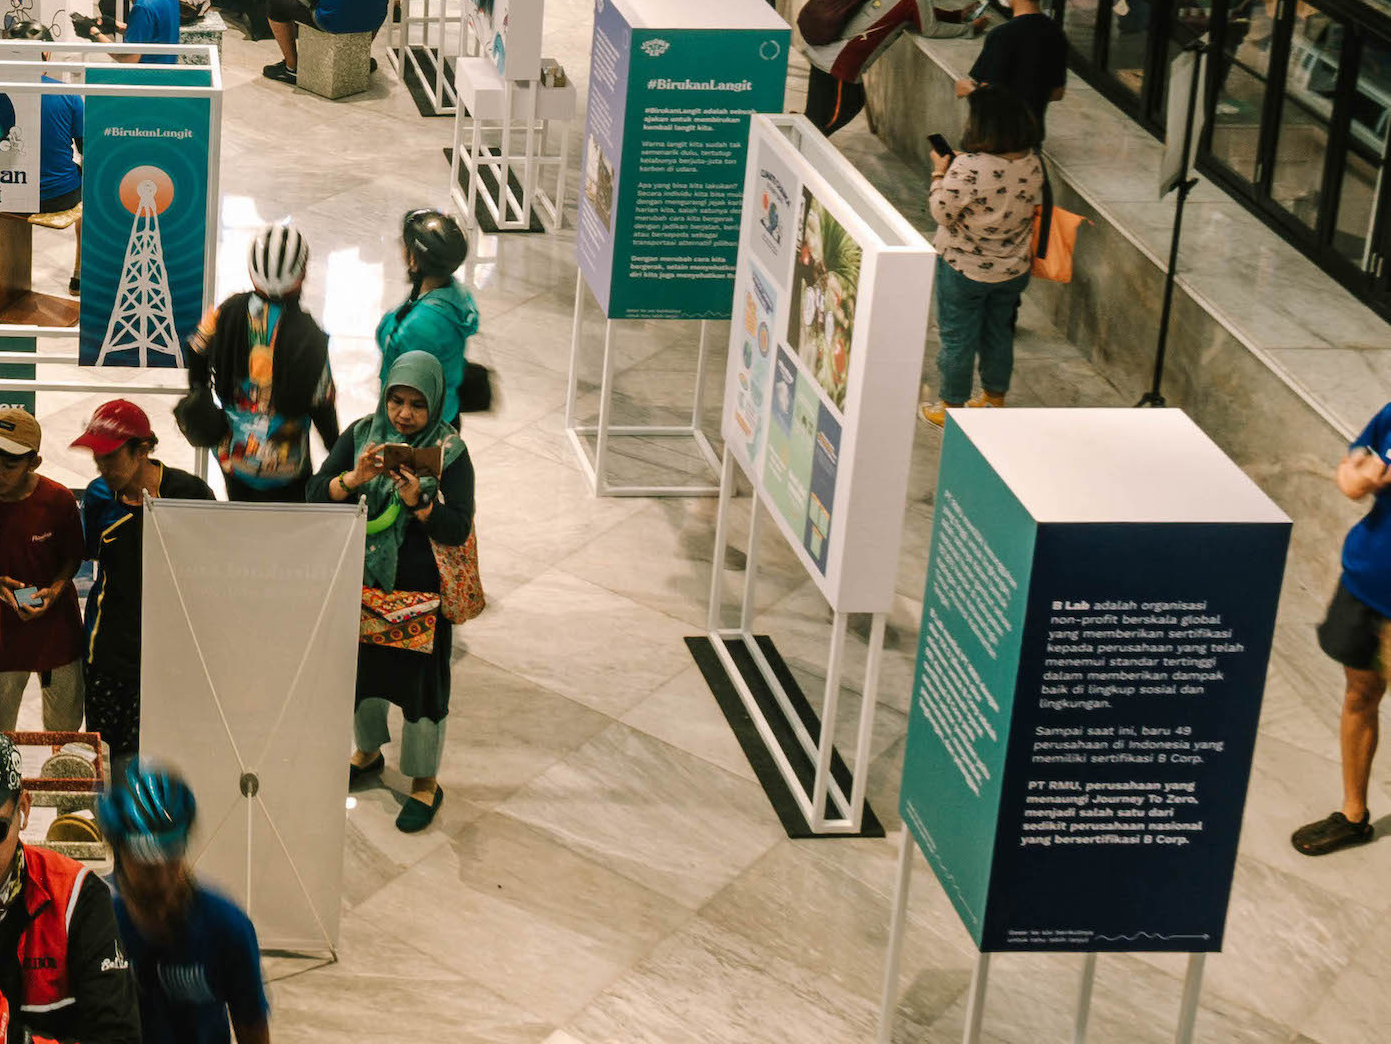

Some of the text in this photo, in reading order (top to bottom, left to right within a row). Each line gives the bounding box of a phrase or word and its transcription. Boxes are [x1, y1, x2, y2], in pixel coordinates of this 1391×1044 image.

[647, 79, 752, 92] #BirukanLangit
[104, 127, 193, 141] #BirukanLangit
[1052, 601, 1207, 612] B Lab adalah organisasi
[1051, 615, 1221, 626] non-profit berskala global
[1048, 629, 1232, 641] yang memberikan sertifikasi
[1047, 643, 1244, 654] kepada perusahaan yang telah
[1045, 657, 1216, 668] menemui standar tertinggi
[1043, 671, 1224, 682] dalam memberikan dampak
[1041, 685, 1204, 696] baik di lingkup sosial dan
[1039, 699, 1112, 710] lingkungan.
[1035, 726, 1192, 737] Sampai saat ini, baru 49
[1033, 740, 1224, 752] perusahaan di Indonesia yang
[1032, 753, 1203, 765] memiliki sertifikasi B Corp.
[1028, 781, 1196, 792] PT RMU, perusahaan yang
[1026, 794, 1199, 806] menaungi Journey To Zero,
[1025, 808, 1174, 819] menjadi salah satu dari
[1023, 821, 1202, 832] sedikit perusahaan nasional
[1020, 835, 1189, 846] yang bersertifikasi B Corp.
